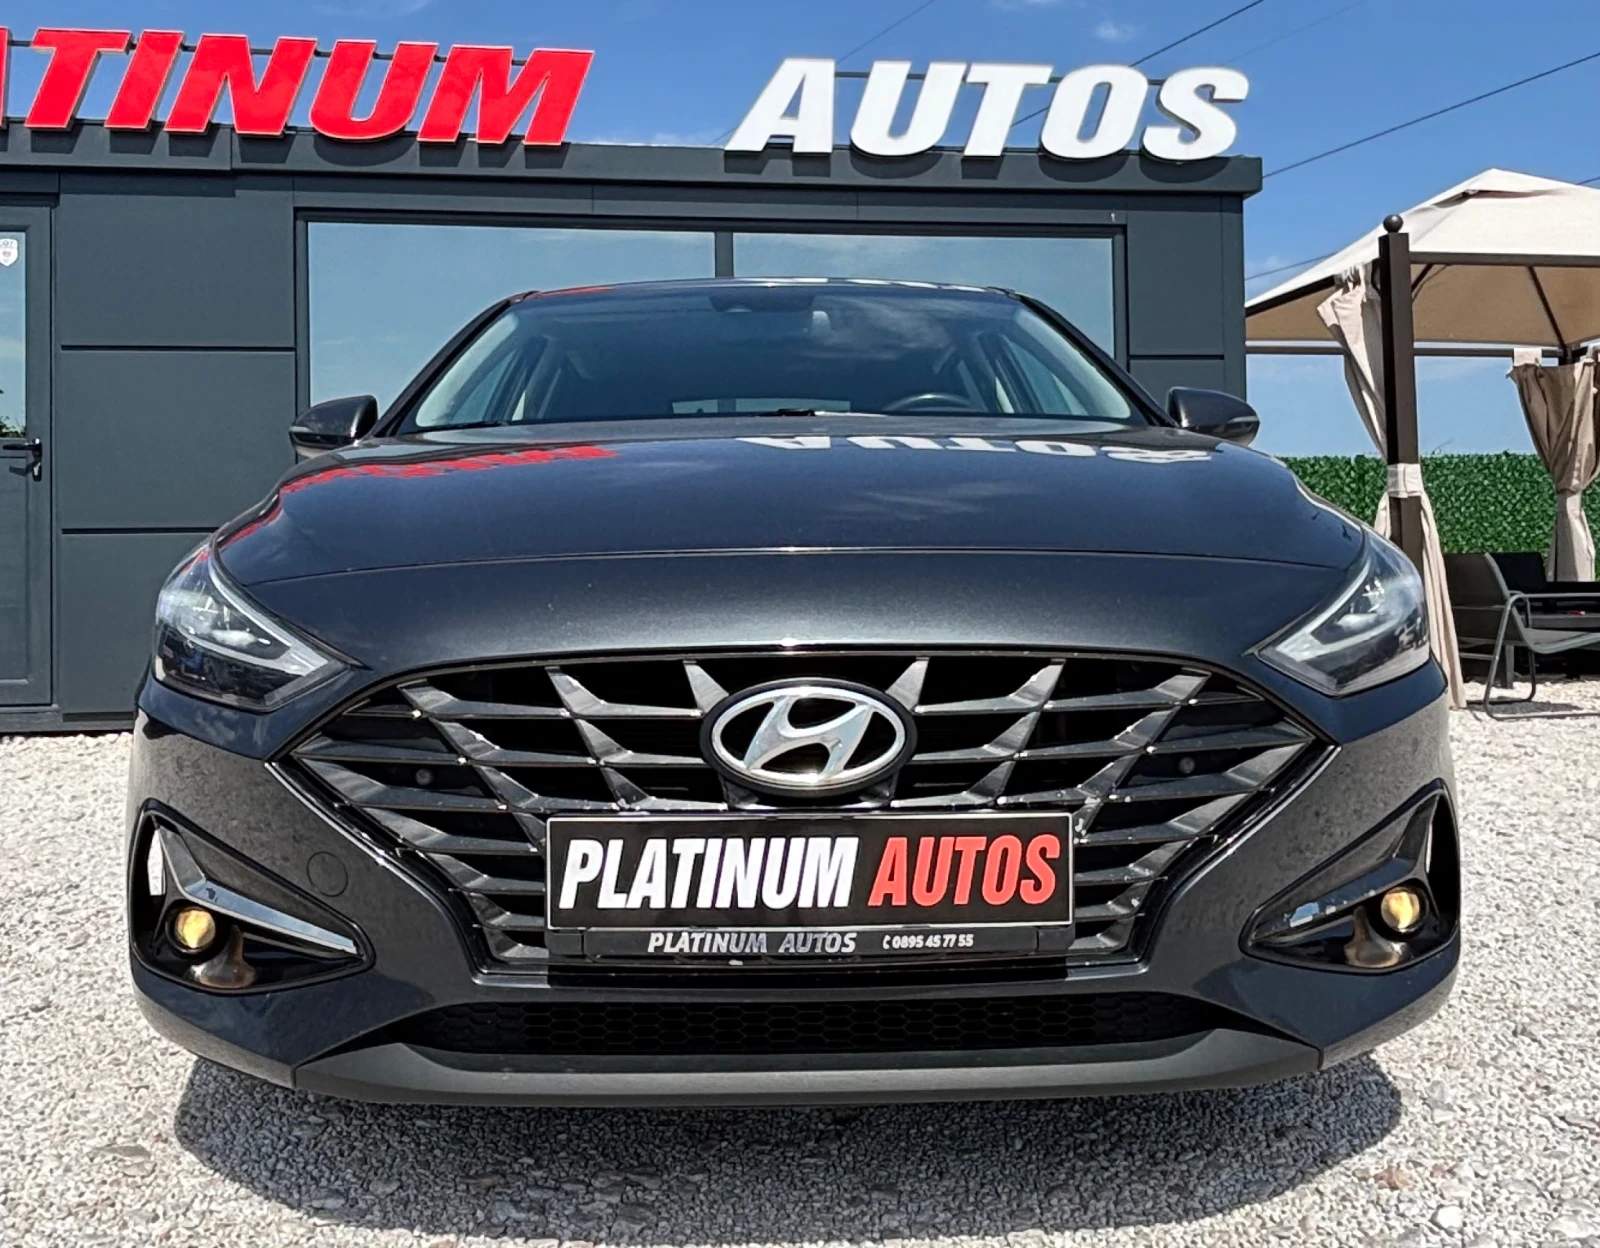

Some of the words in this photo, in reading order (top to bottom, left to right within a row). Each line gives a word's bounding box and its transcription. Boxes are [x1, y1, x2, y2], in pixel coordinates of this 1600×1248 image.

[0, 27, 594, 146] TINUM
[724, 58, 1249, 162] AUTOS
[558, 837, 859, 910] PLATINUM
[867, 834, 1061, 907] AUTOS
[647, 931, 768, 953] PLATINUM
[778, 932, 857, 953] AUTOS
